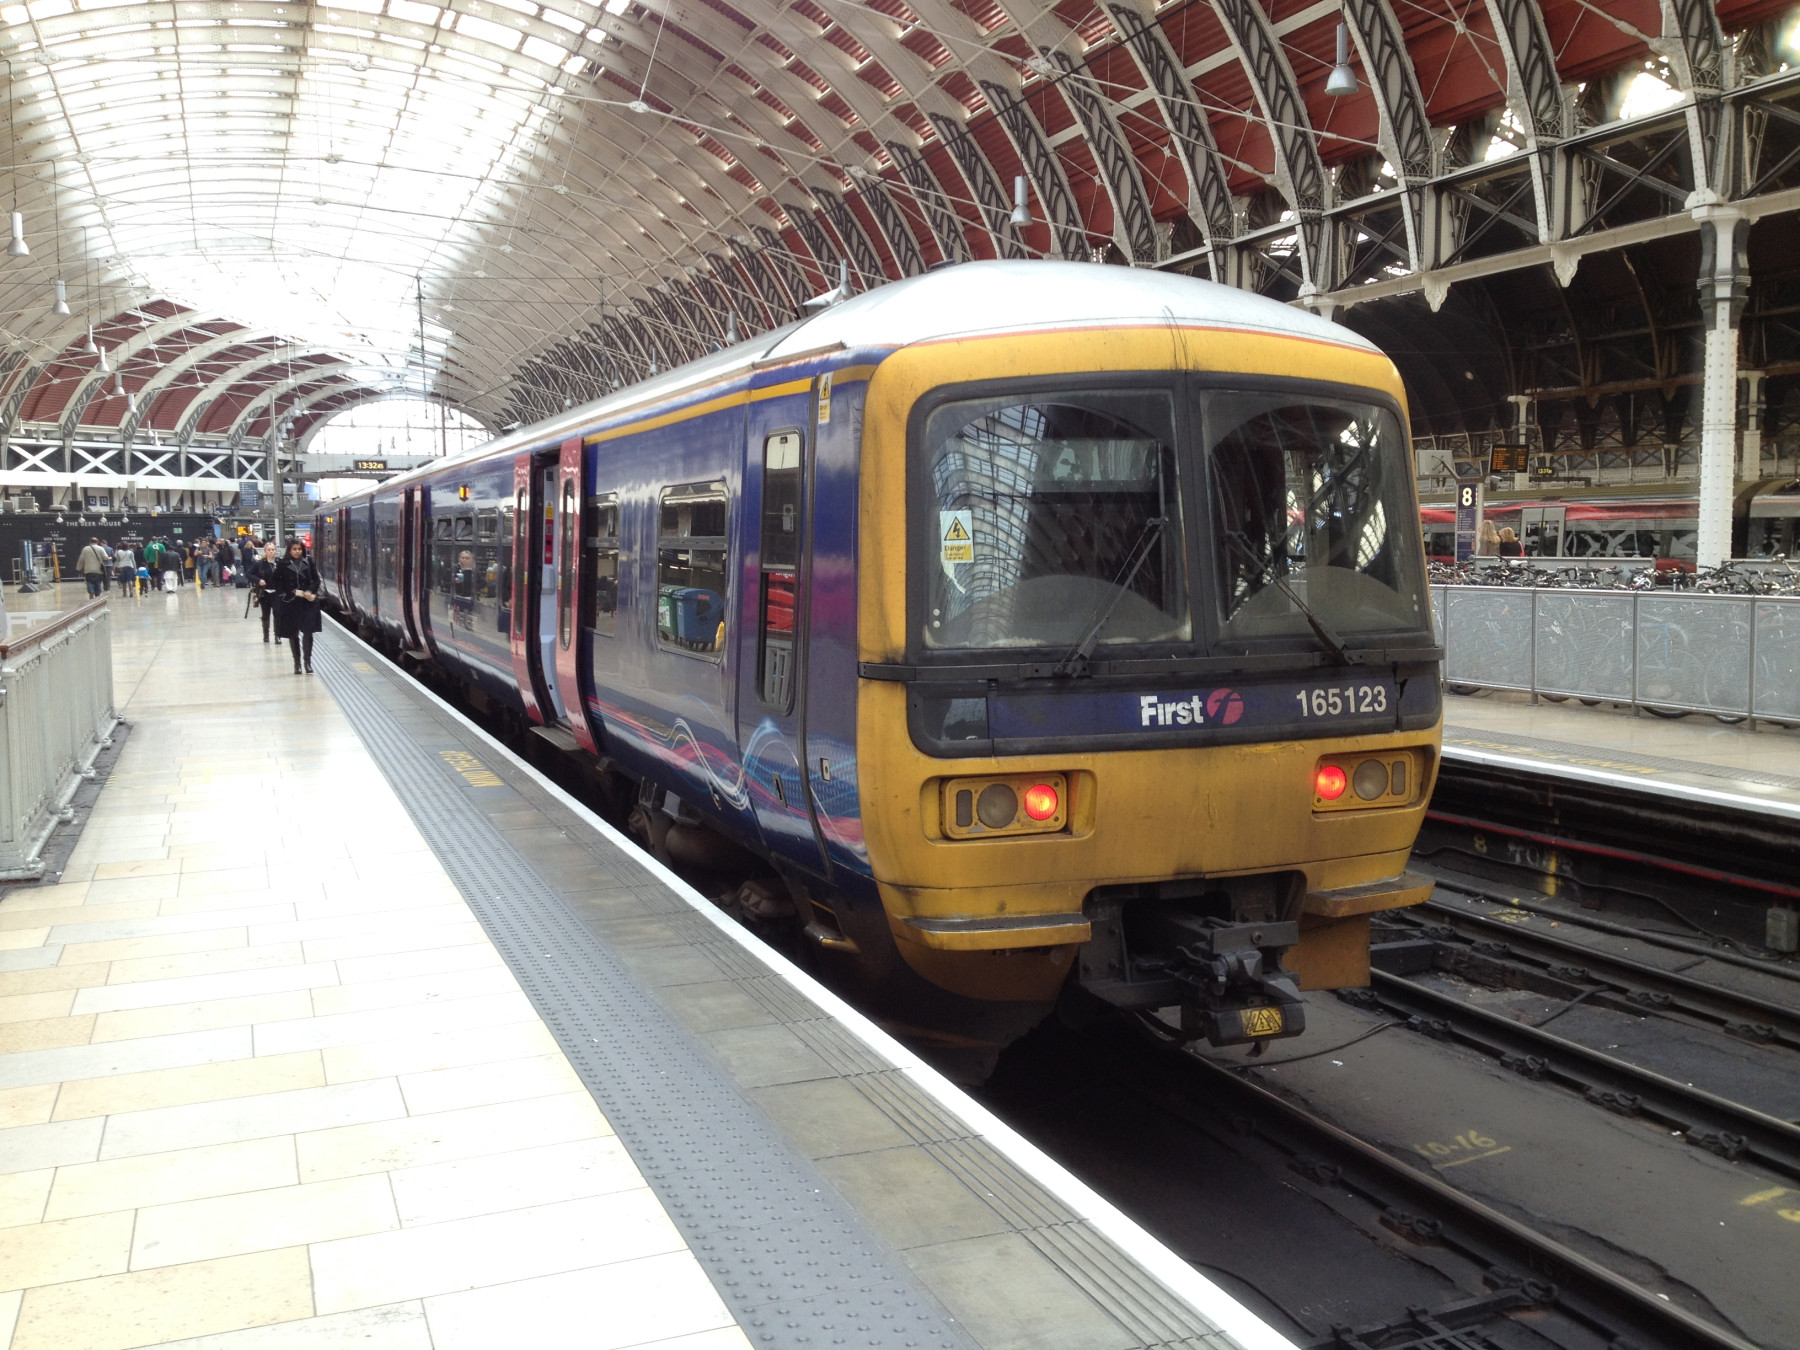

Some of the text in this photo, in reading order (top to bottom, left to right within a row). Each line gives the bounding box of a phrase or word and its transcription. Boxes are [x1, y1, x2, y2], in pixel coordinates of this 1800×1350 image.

[89, 497, 96, 505] 12
[101, 497, 107, 505] 13
[1461, 487, 1473, 507] 8
[1140, 695, 1204, 727] First
[1296, 685, 1387, 717] 165123
